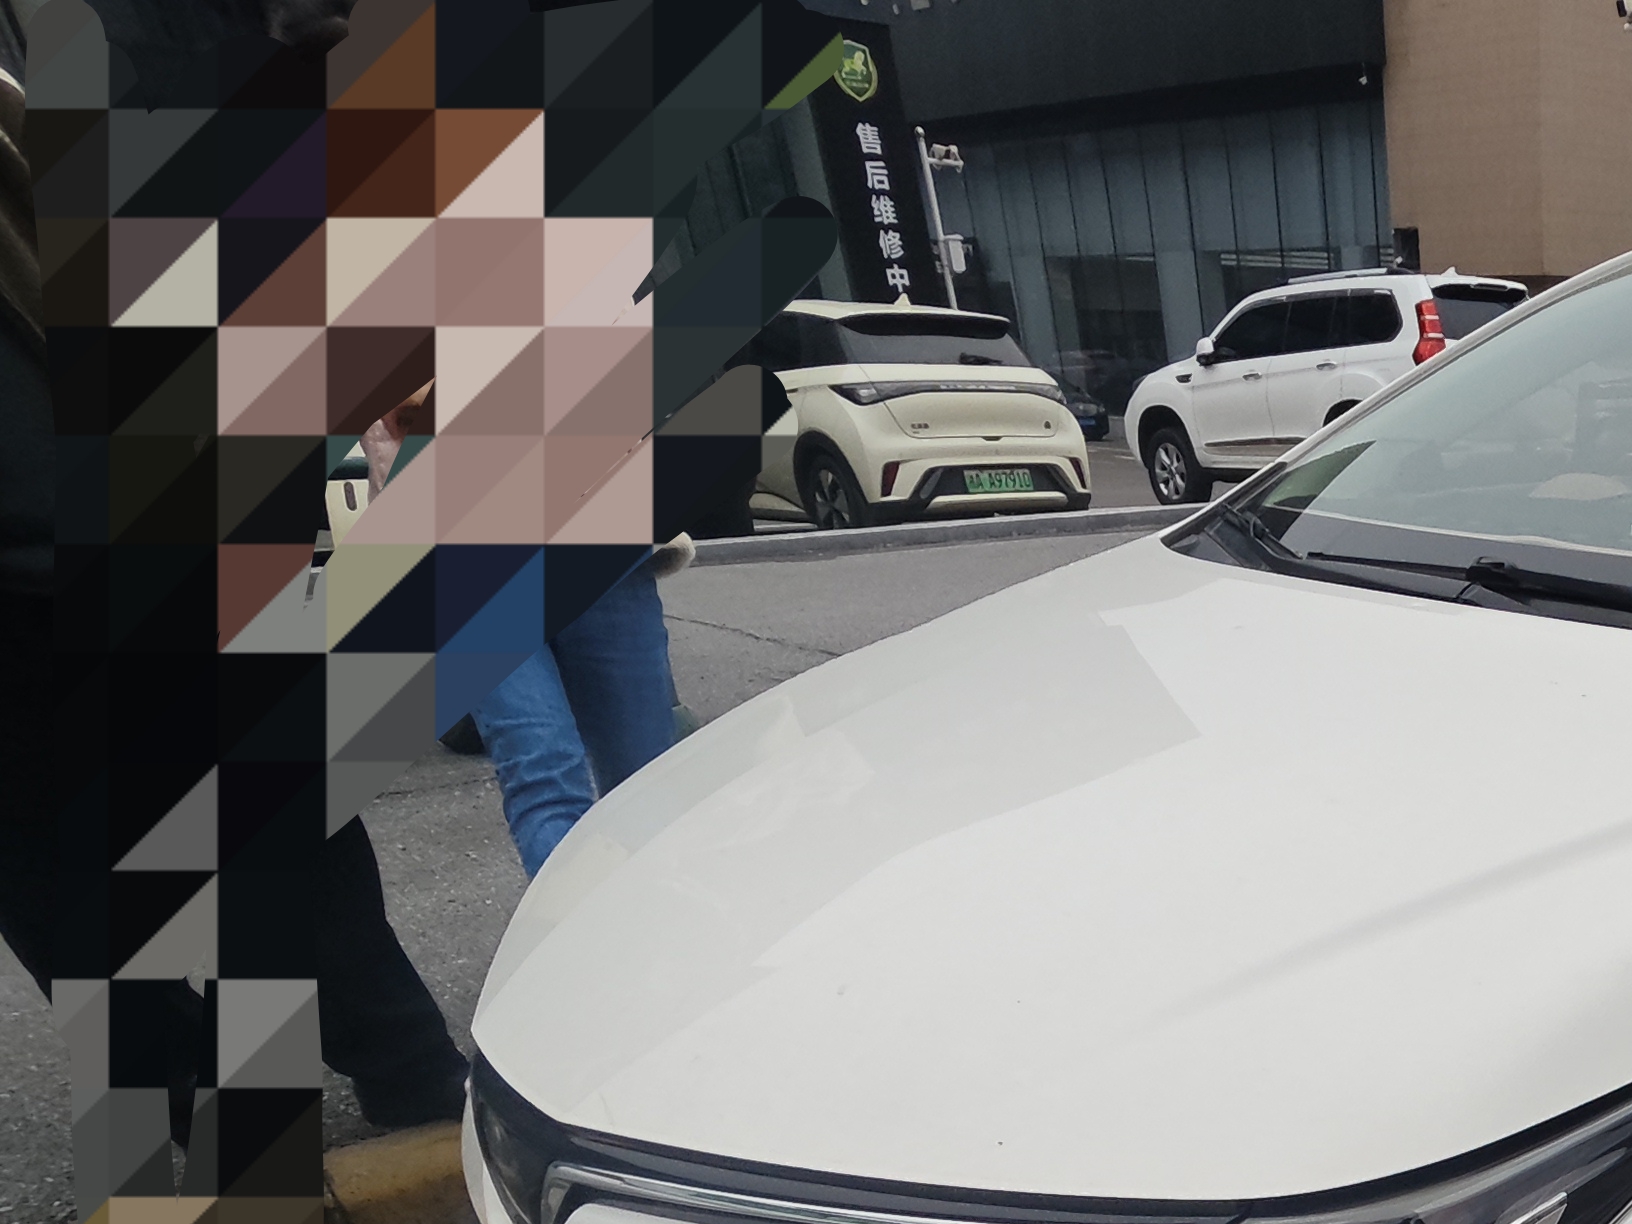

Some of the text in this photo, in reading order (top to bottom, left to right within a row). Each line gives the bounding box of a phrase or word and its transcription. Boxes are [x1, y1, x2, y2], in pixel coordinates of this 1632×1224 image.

[855, 122, 911, 293] 售后维修中
